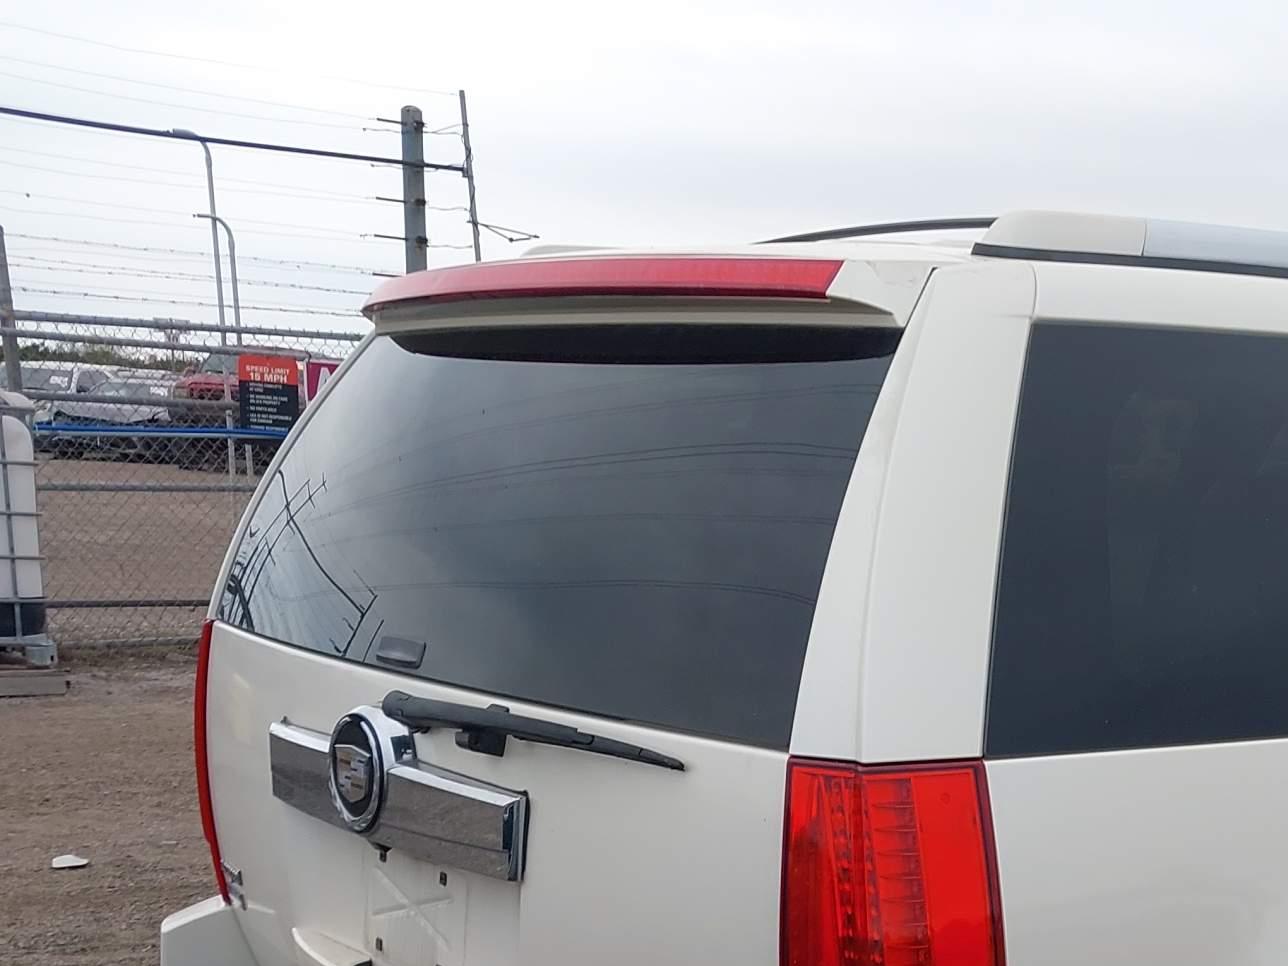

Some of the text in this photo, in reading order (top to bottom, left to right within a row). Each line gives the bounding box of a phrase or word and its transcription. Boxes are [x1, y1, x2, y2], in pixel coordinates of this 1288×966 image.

[245, 365, 290, 375] SPEED LIMIT
[249, 372, 288, 383] 15 MPH
